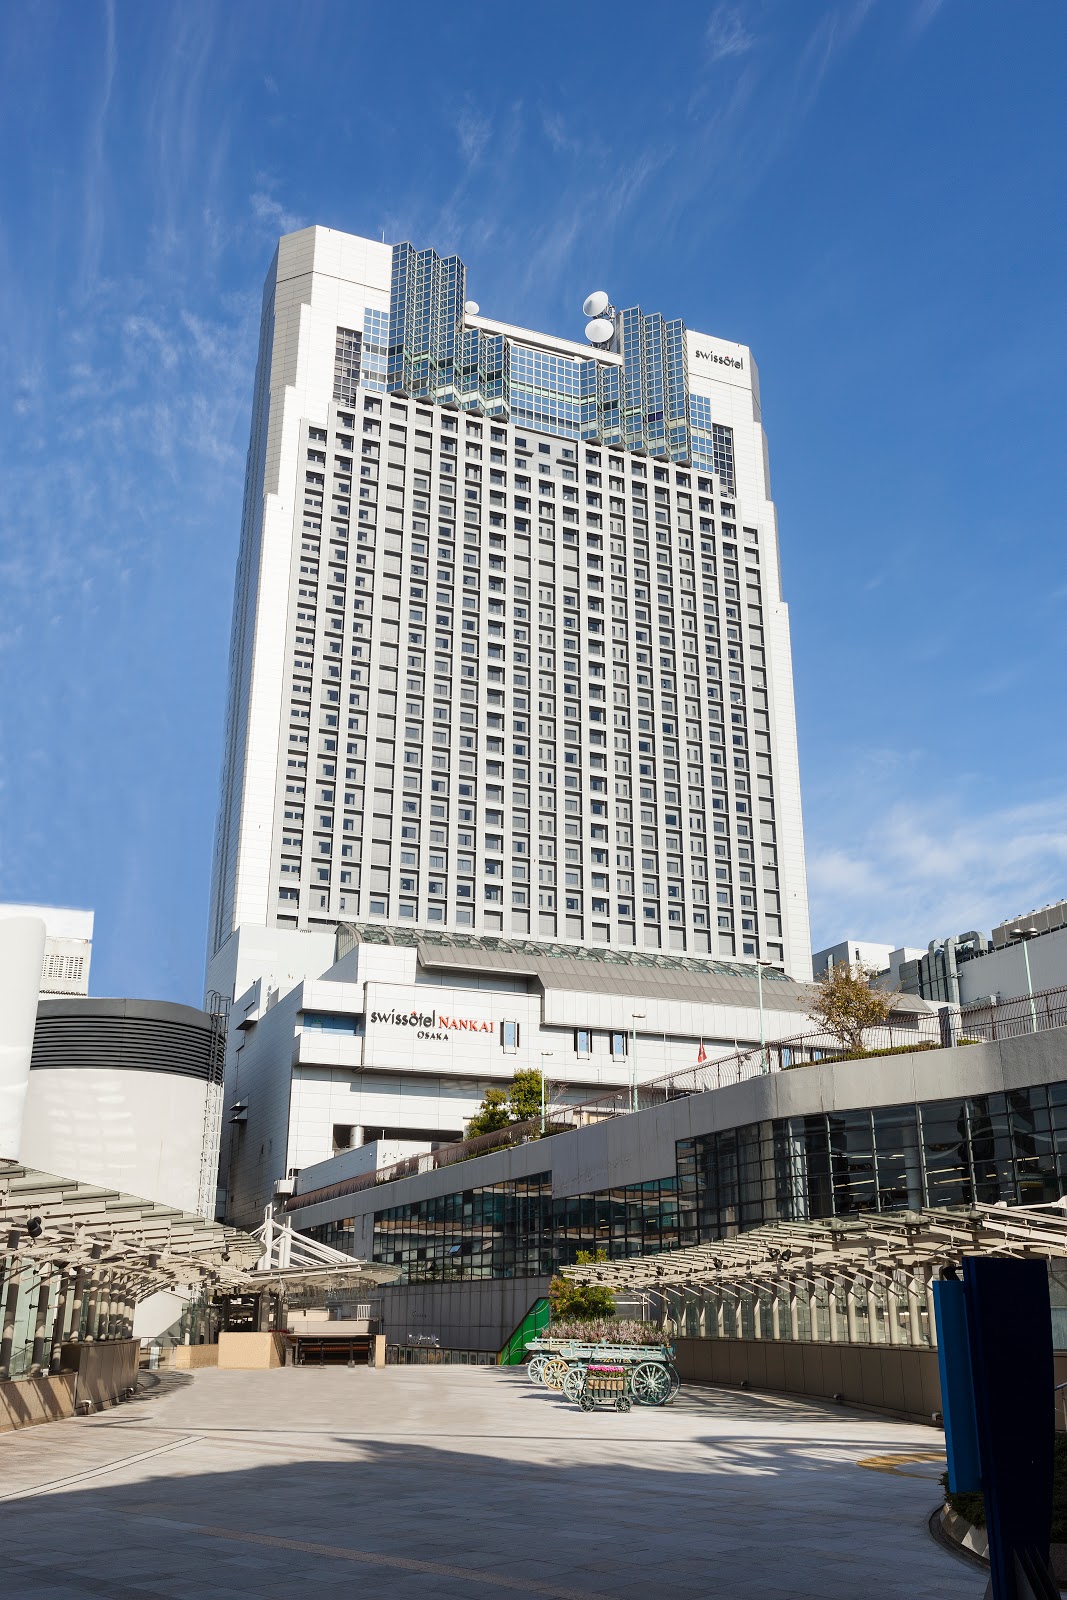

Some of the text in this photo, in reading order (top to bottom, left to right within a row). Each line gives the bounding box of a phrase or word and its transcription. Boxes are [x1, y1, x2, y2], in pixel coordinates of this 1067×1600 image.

[370, 1009, 495, 1033] swissôtel NANKAI
[417, 1031, 449, 1041] OSAKA
